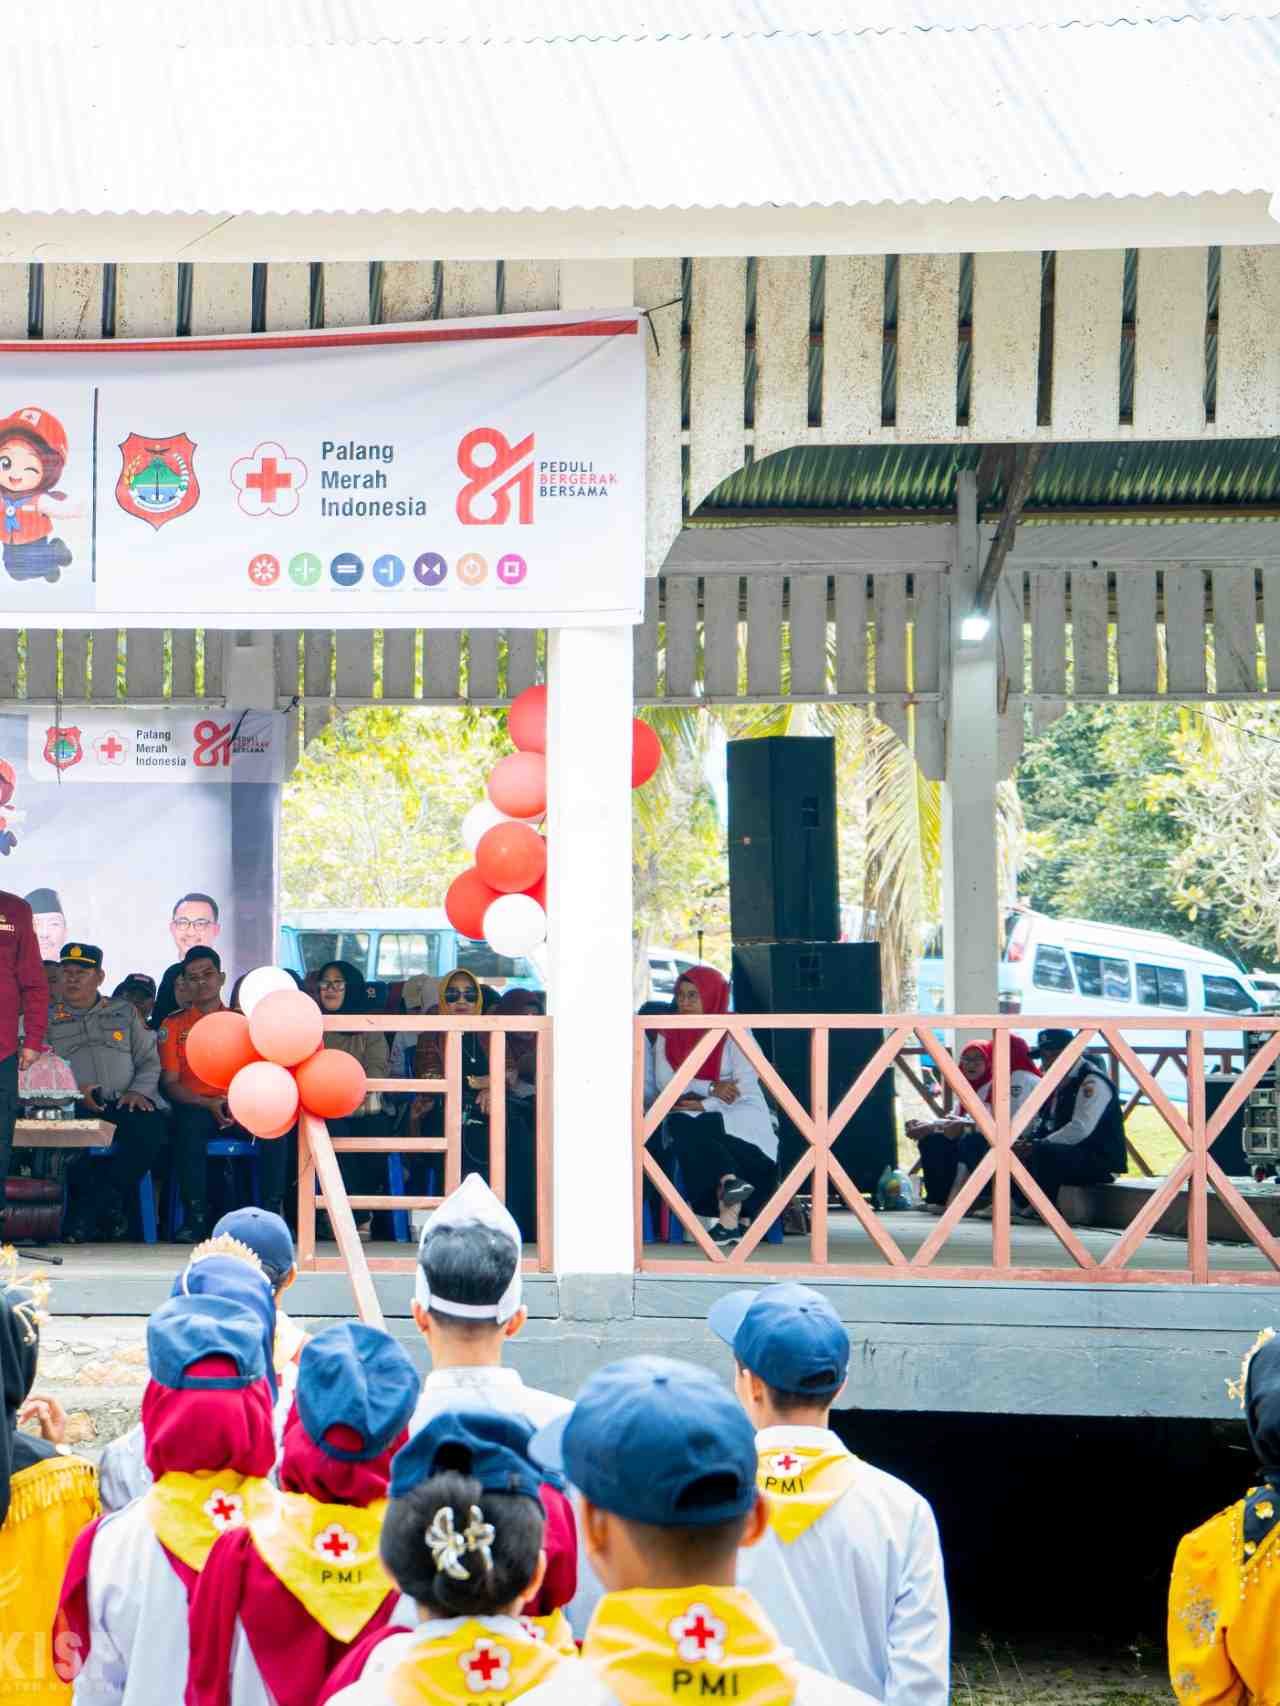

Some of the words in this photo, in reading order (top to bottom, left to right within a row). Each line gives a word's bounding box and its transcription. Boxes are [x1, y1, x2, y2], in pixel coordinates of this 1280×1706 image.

[321, 441, 395, 463] Palang
[540, 461, 593, 473] PEDULI
[321, 470, 388, 489] Merah
[540, 473, 618, 485] BERGERAK
[540, 485, 609, 498] BERSAMA
[321, 497, 428, 517] Indonesia
[136, 729, 172, 741] Palang
[136, 743, 168, 753] Merah
[136, 756, 187, 767] Indonesia
[765, 1476, 805, 1494] PMI
[322, 1569, 362, 1584] PMI
[672, 1669, 739, 1697] PMI
